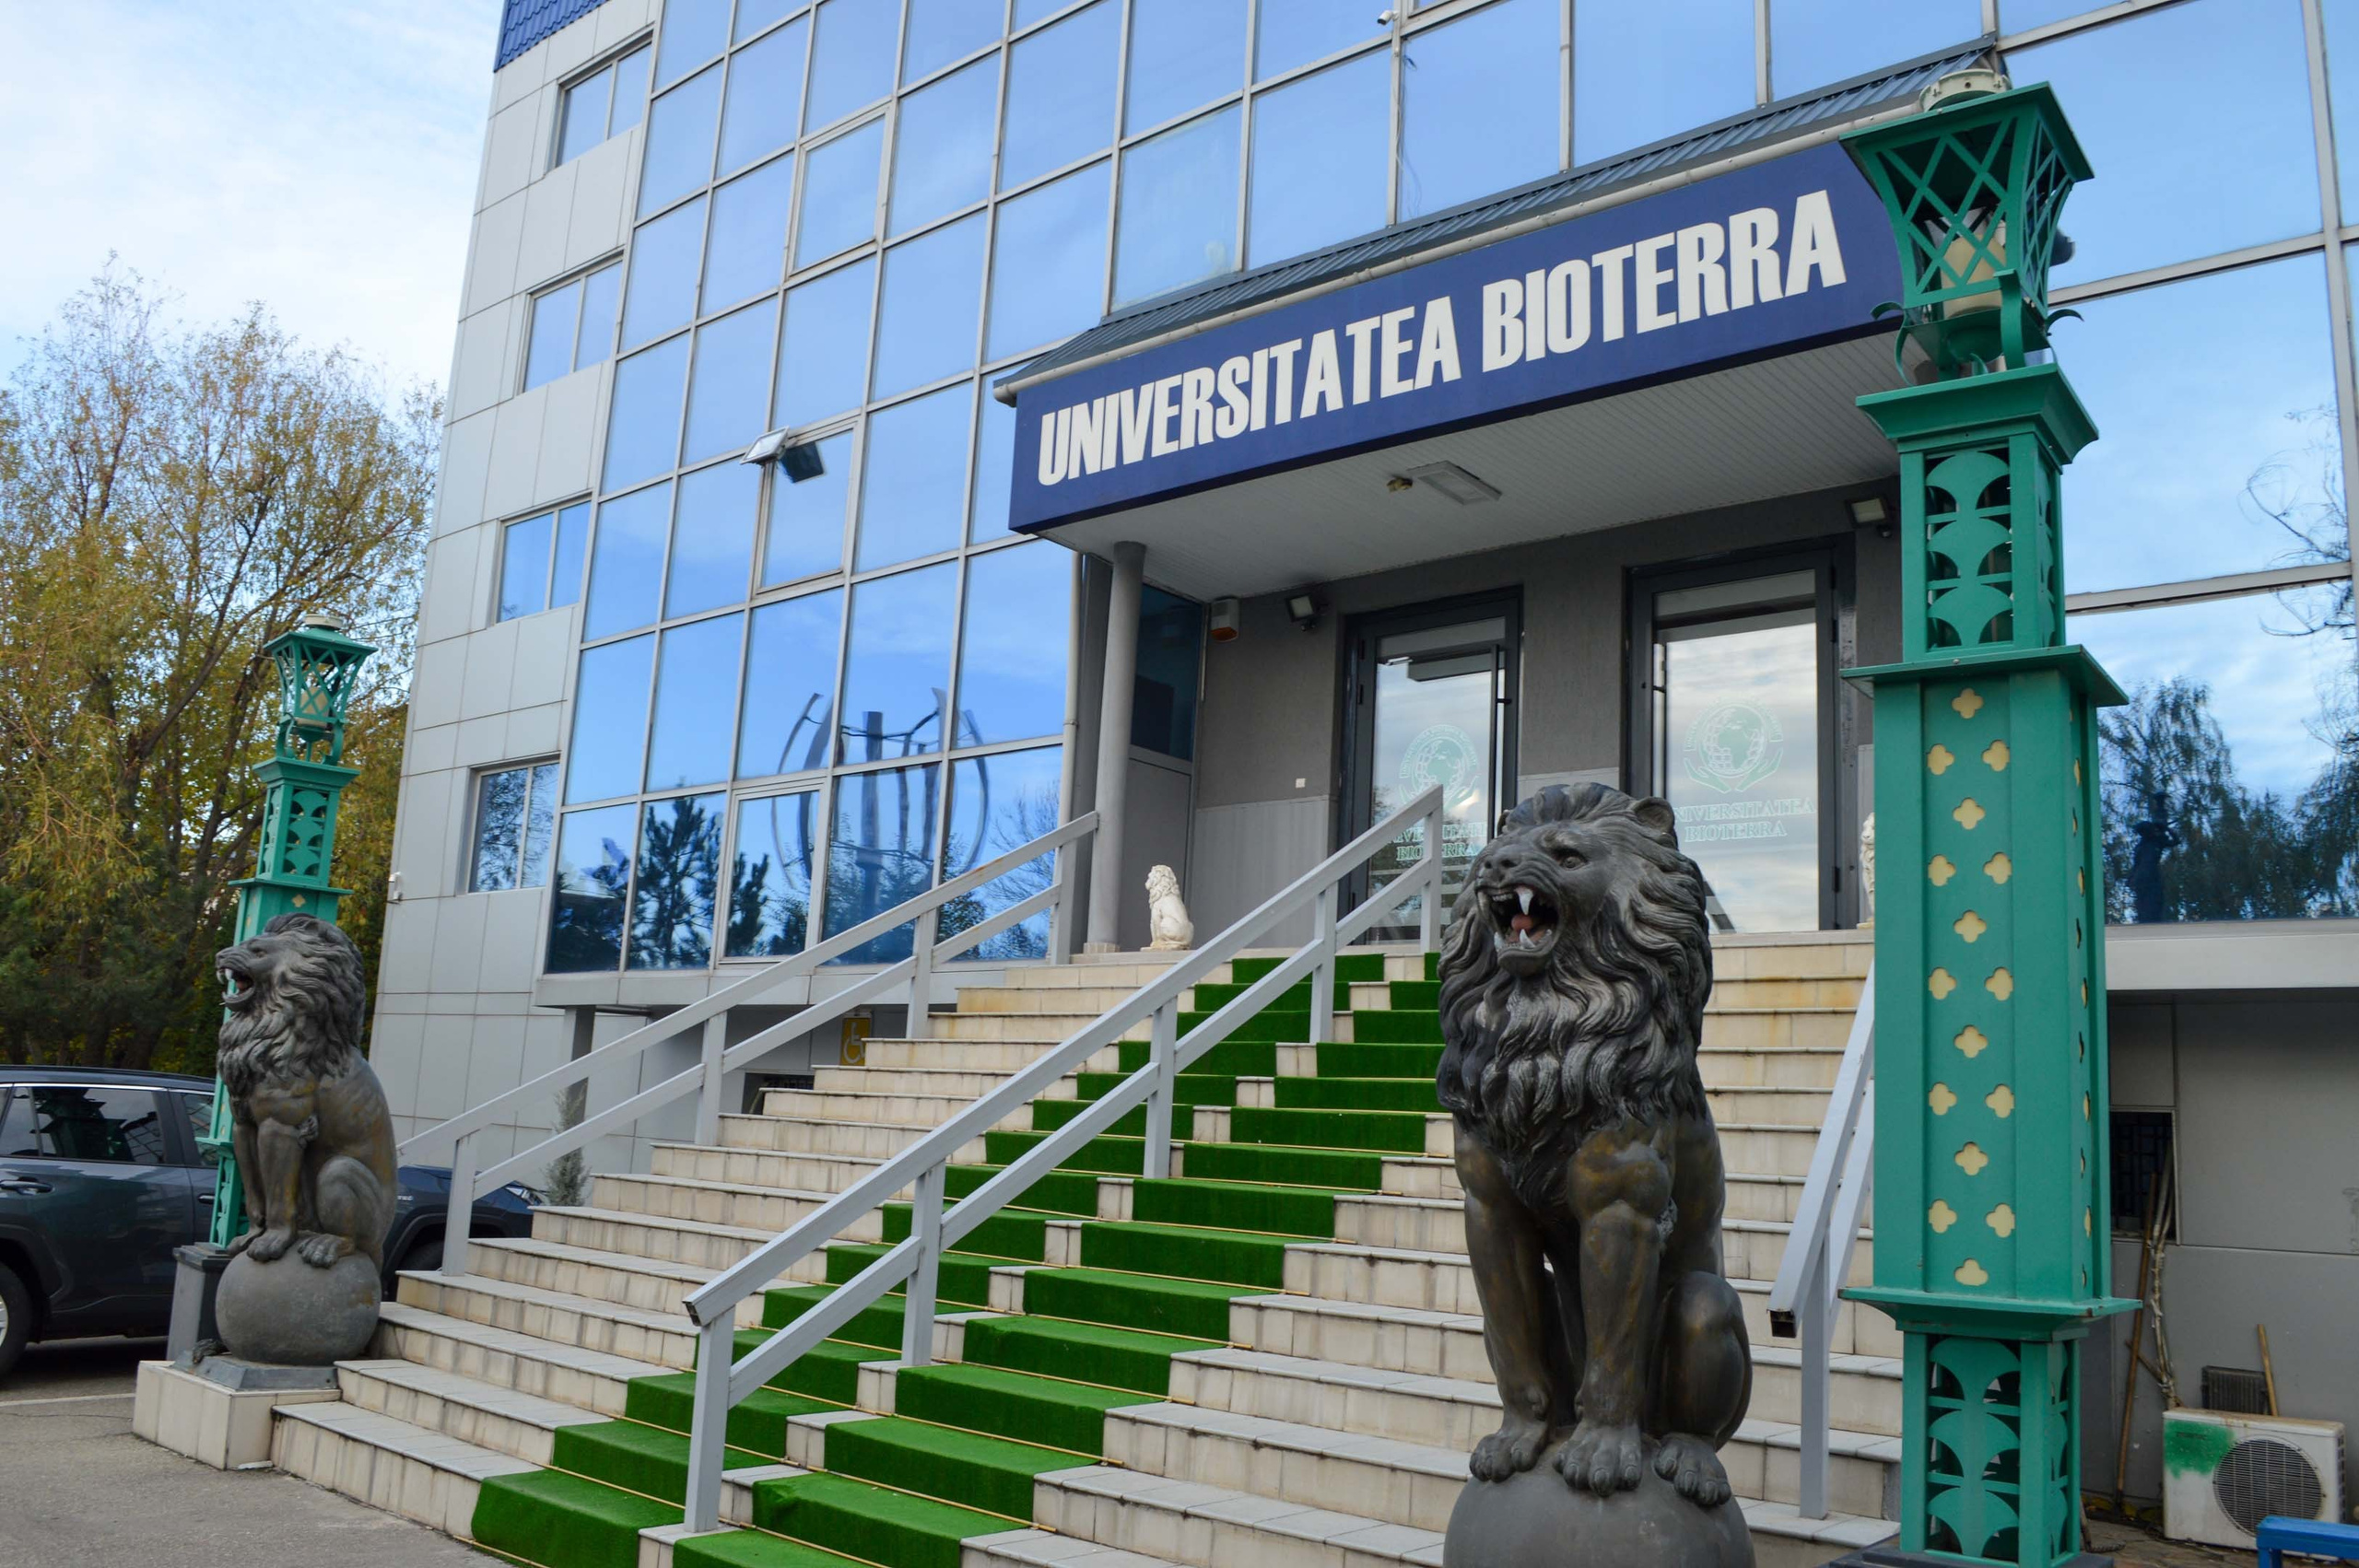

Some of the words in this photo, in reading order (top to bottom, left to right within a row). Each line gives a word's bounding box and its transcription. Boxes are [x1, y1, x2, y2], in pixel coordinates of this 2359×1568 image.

[1039, 296, 1461, 486] UNIVERSITATEA
[1483, 190, 1848, 373] BIOTERRA
[1673, 797, 1816, 823] NIVERSITATEA
[1684, 820, 1788, 842] BIOTERRA
[1396, 841, 1478, 861] BIORRA
